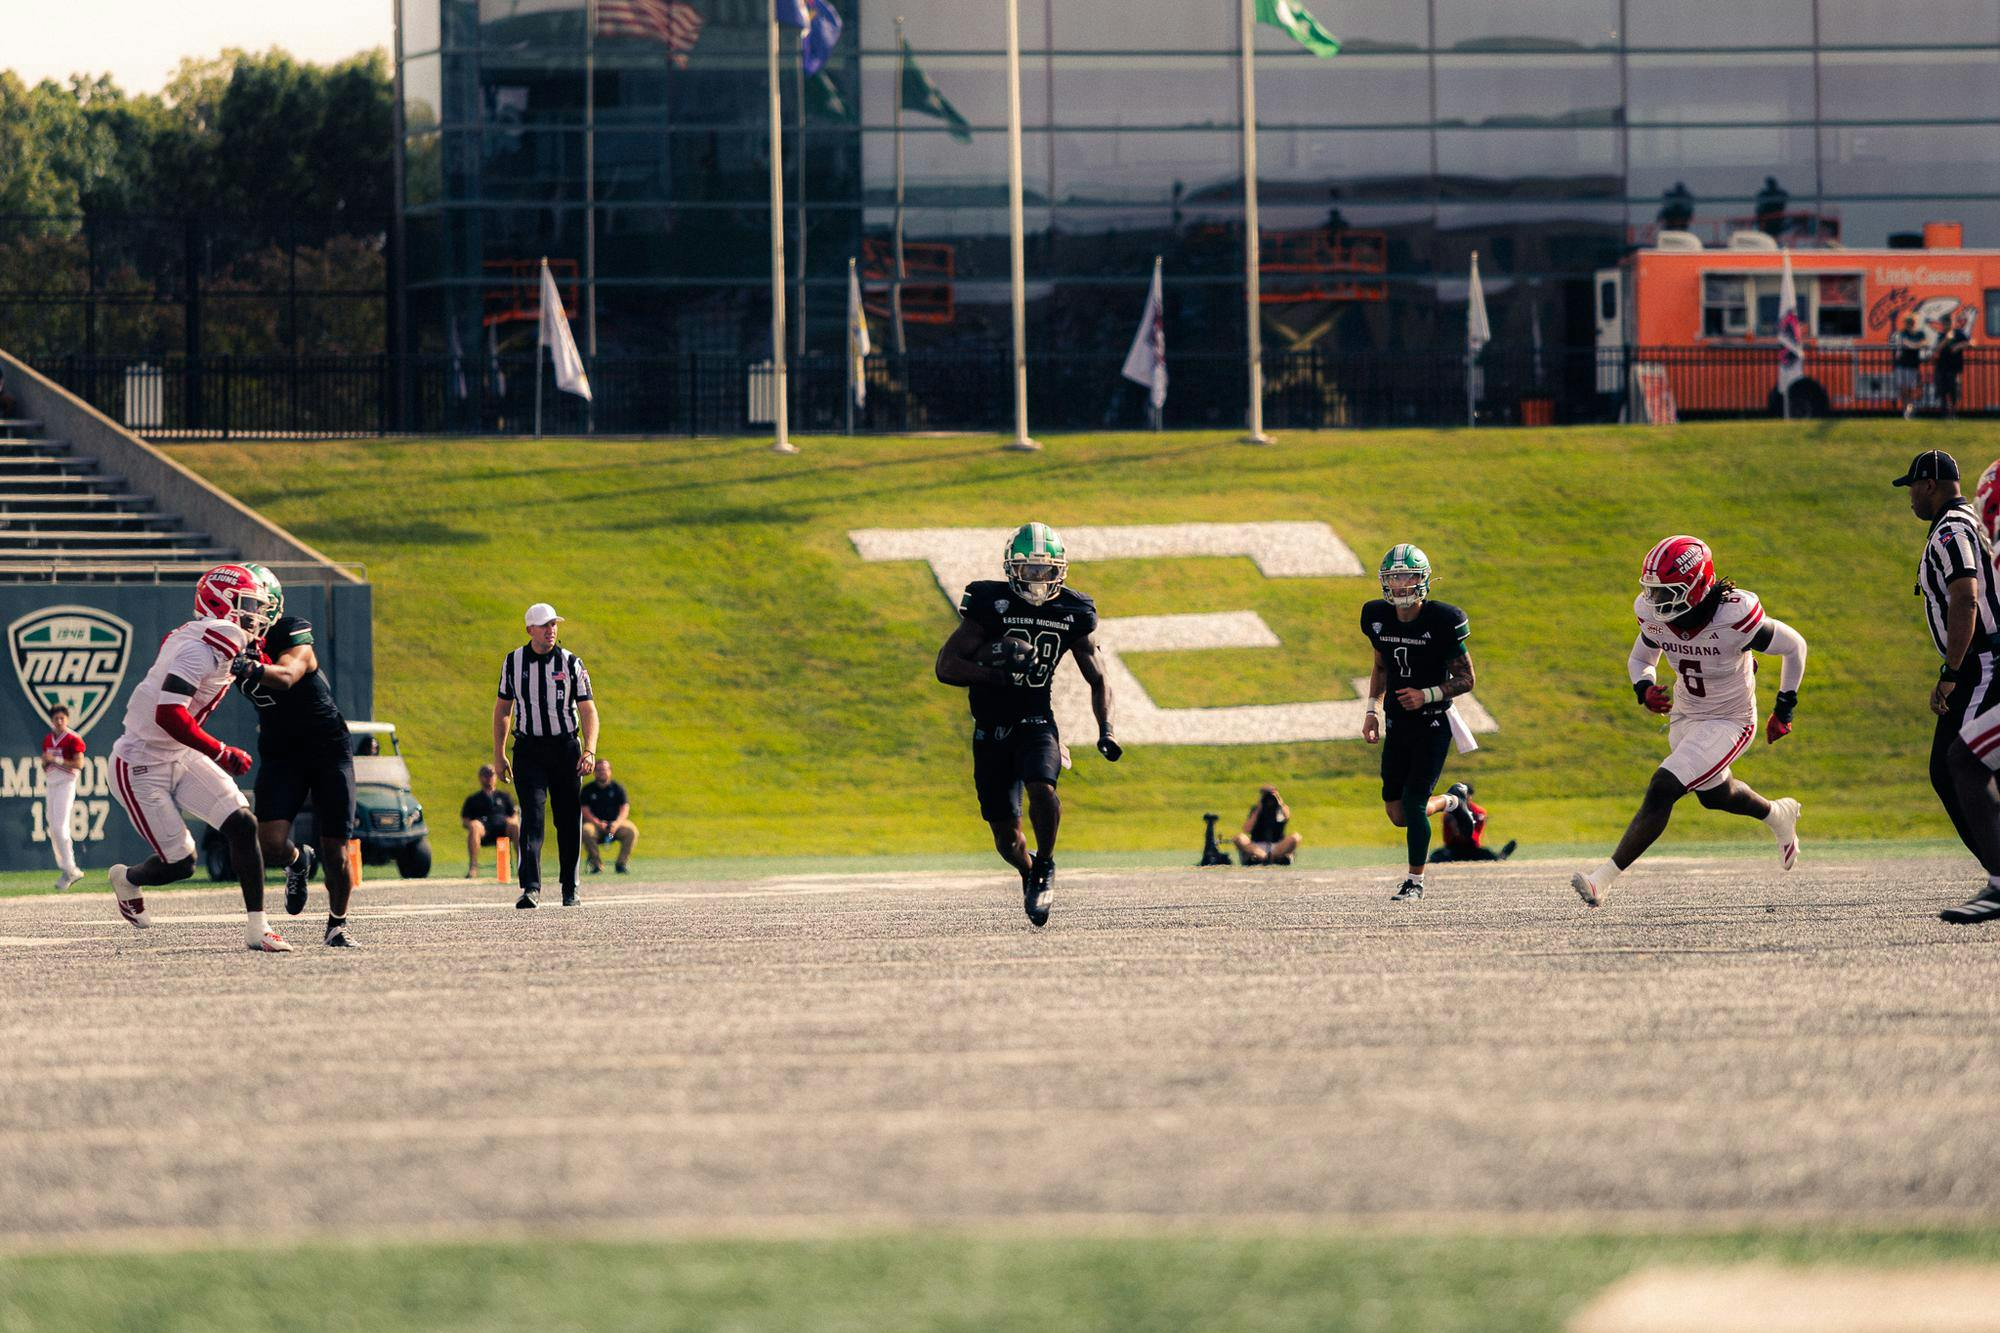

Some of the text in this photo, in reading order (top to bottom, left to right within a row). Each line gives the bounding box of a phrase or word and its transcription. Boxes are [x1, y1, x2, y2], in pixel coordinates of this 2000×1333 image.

[1679, 552, 1704, 575] CAJUNS
[1003, 617, 1070, 630] EASTERN MICHIGAN
[1401, 637, 1426, 645] MICHIGAN
[1656, 640, 1721, 656] LOUISIANA
[22, 650, 121, 683] MAC
[1394, 647, 1411, 677] 1
[1678, 658, 1707, 698] 6
[556, 689, 564, 700] R
[31, 800, 110, 842] 187
